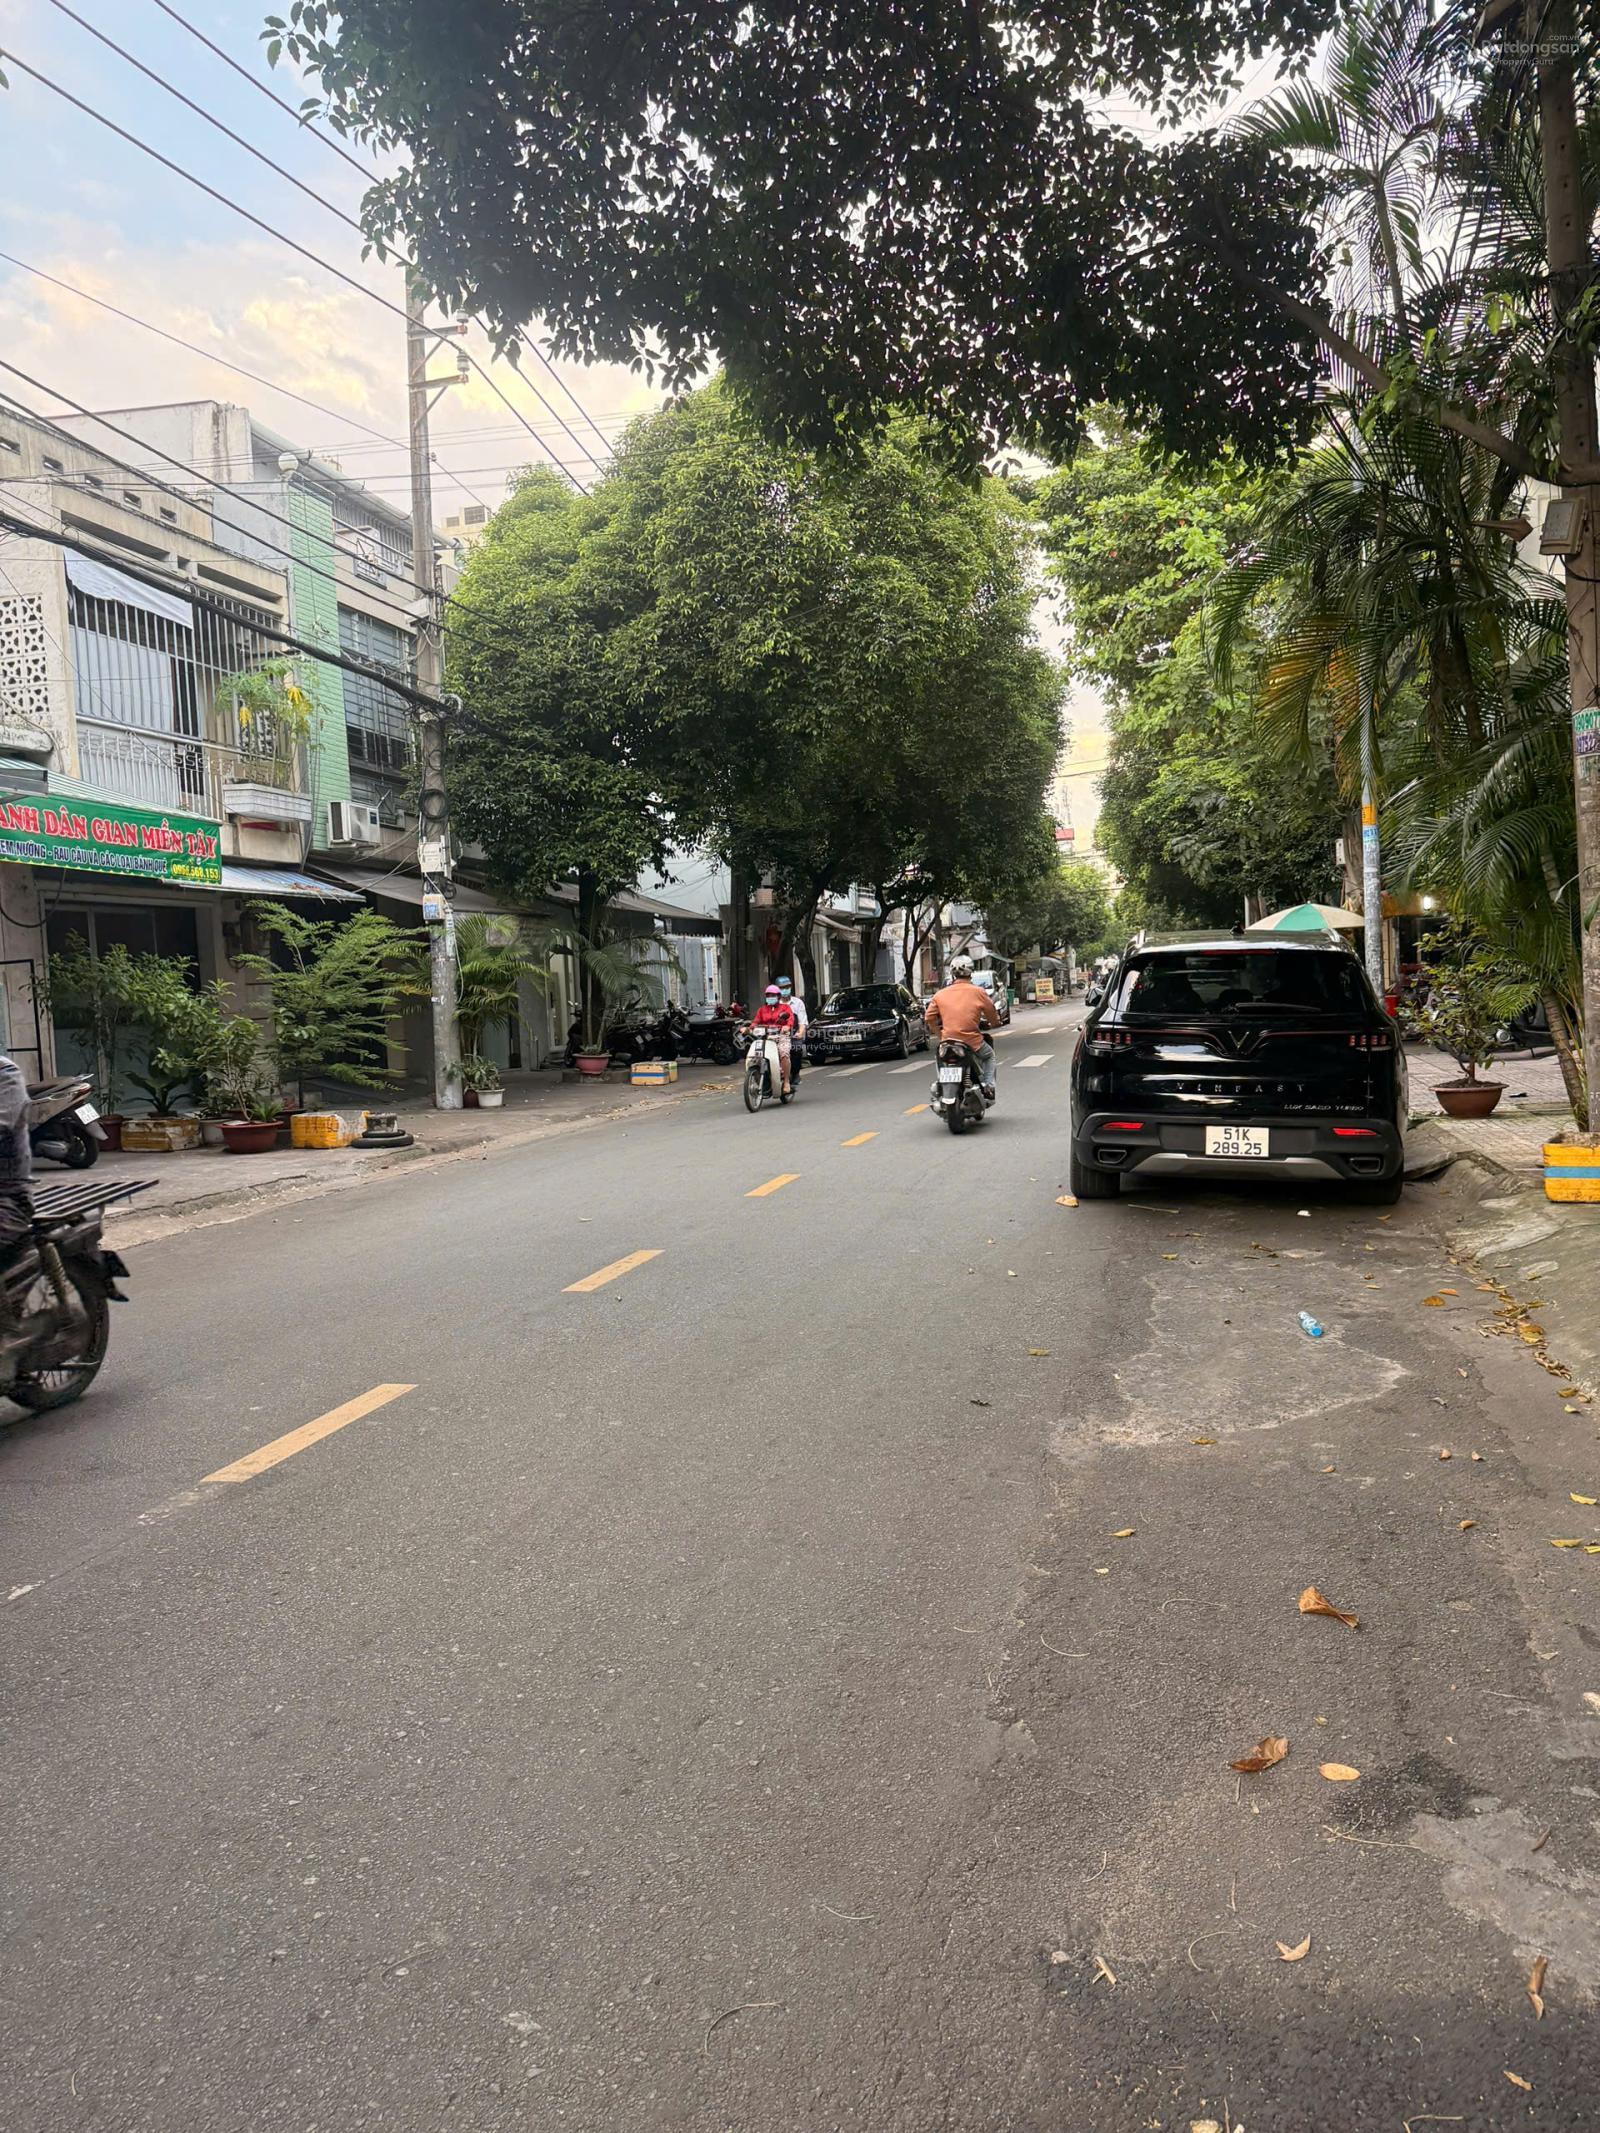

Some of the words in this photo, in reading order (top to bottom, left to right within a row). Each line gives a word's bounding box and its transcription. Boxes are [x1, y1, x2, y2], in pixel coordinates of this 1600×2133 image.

[43, 805, 88, 840] DÂN
[91, 817, 138, 848] GIAN
[186, 828, 217, 858] TÂY
[0, 839, 15, 856] EM
[53, 845, 70, 862] RAU
[87, 848, 99, 866] VÀ
[100, 849, 116, 868] CÁC
[1223, 1128, 1250, 1141] 51K
[1212, 1141, 1262, 1155] 289.25
